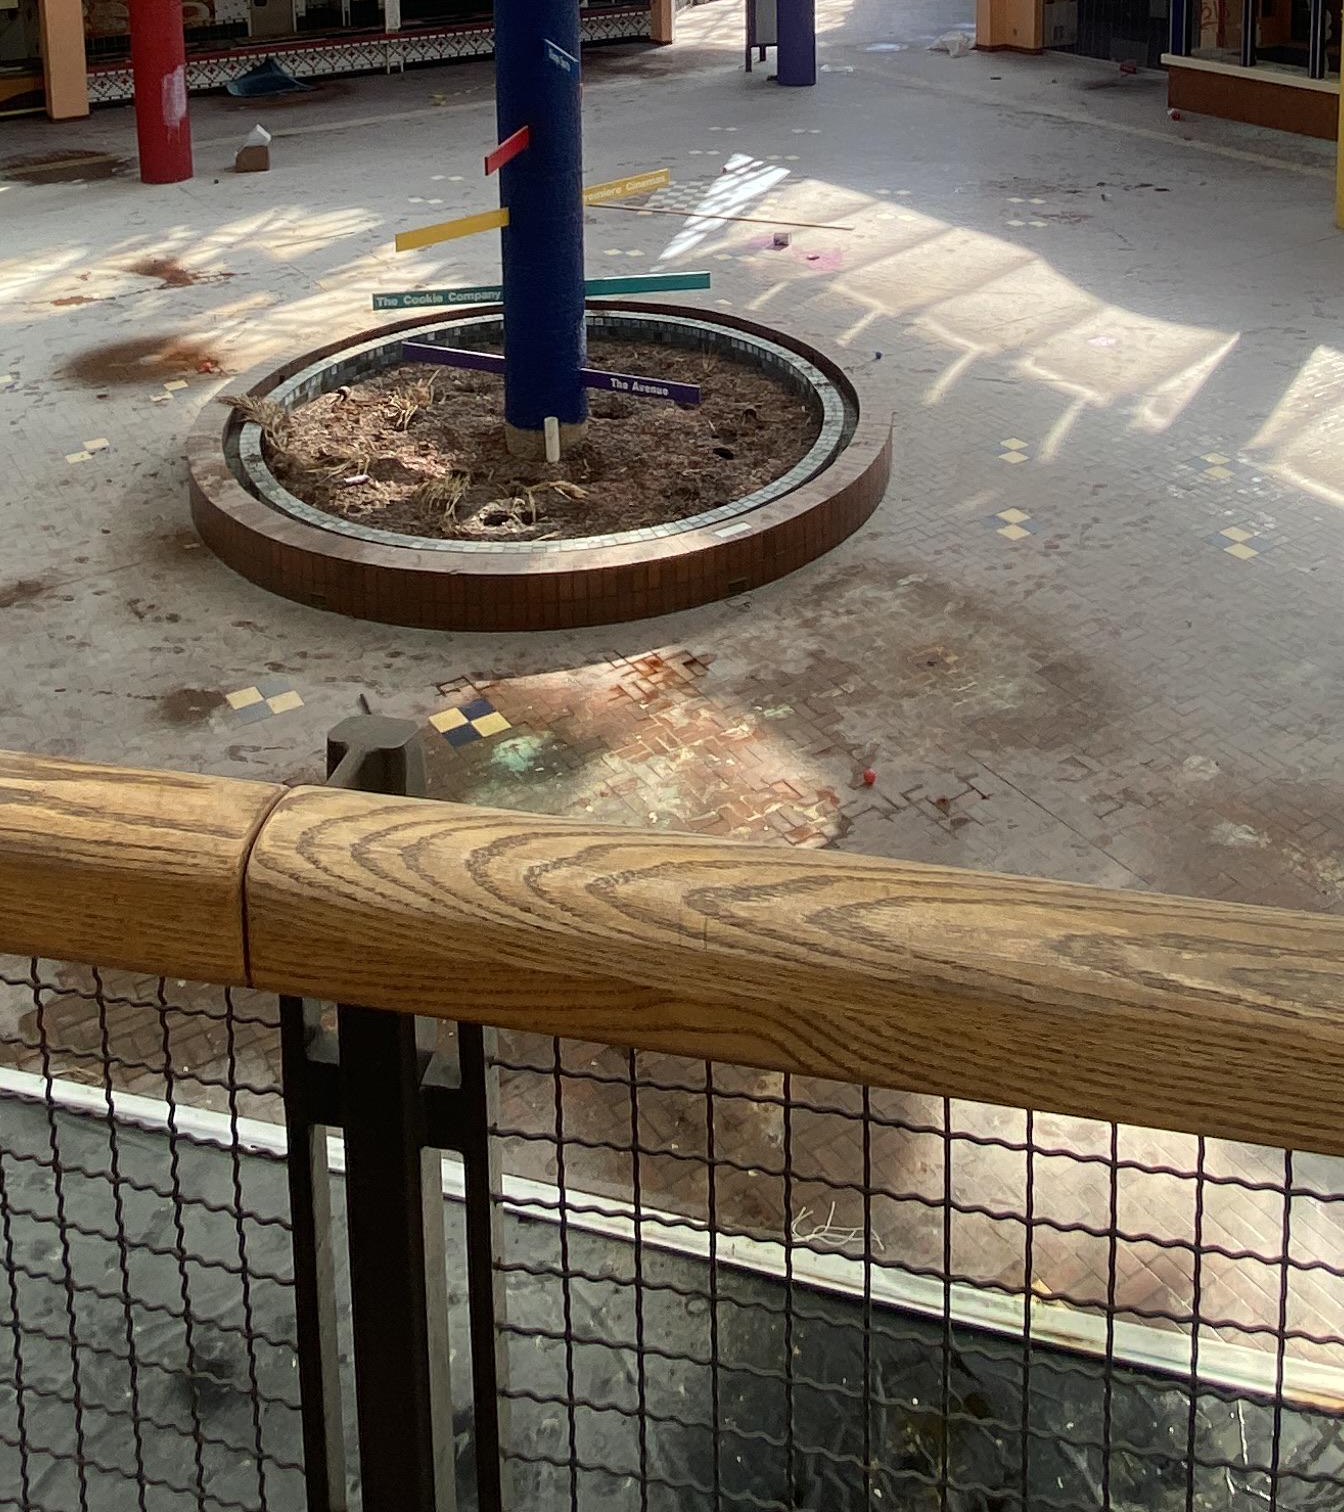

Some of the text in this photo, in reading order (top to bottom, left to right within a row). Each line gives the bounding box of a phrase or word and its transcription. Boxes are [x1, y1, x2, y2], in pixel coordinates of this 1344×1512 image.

[584, 176, 666, 202] remiere Cinemas
[376, 291, 501, 308] The Cookie Company
[610, 378, 670, 396] The Avenue
